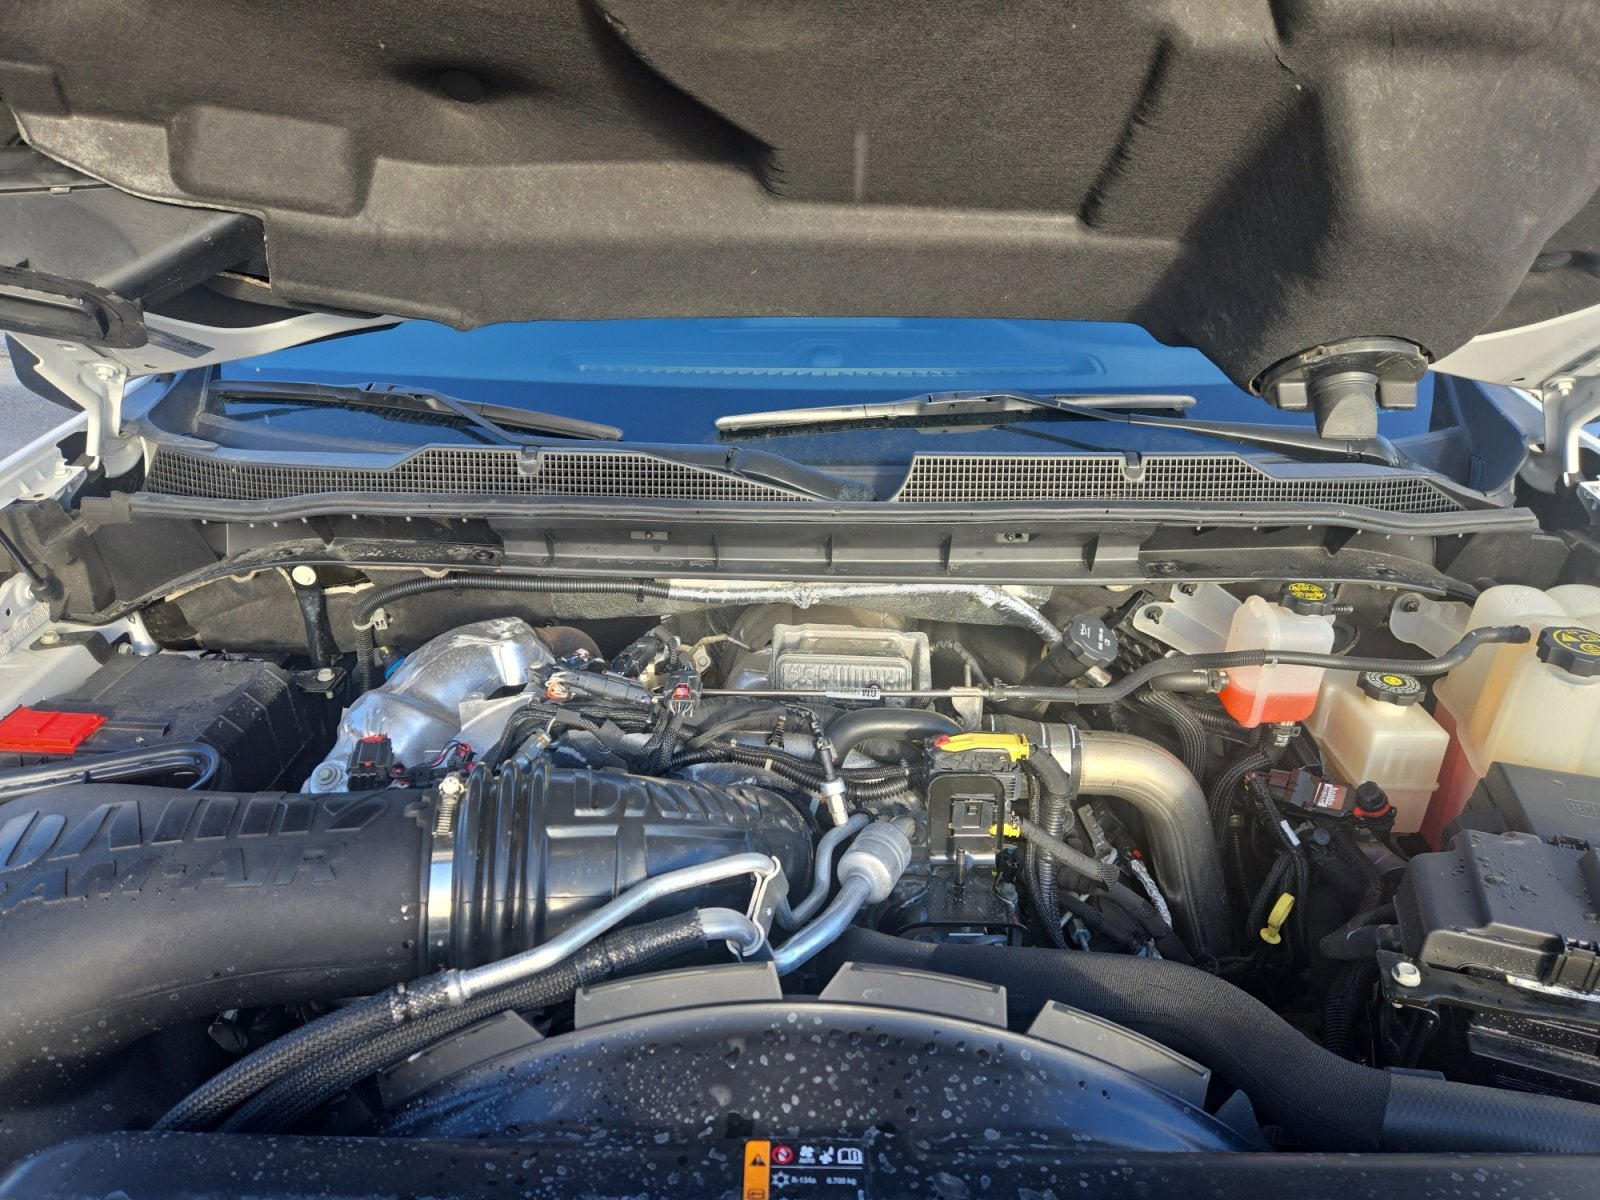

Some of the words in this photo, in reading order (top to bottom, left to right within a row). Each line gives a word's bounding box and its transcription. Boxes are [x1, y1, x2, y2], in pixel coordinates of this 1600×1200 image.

[0, 840, 346, 915] AM-AIR
[791, 1176, 817, 1184] R-134a
[847, 1177, 857, 1186] kg
